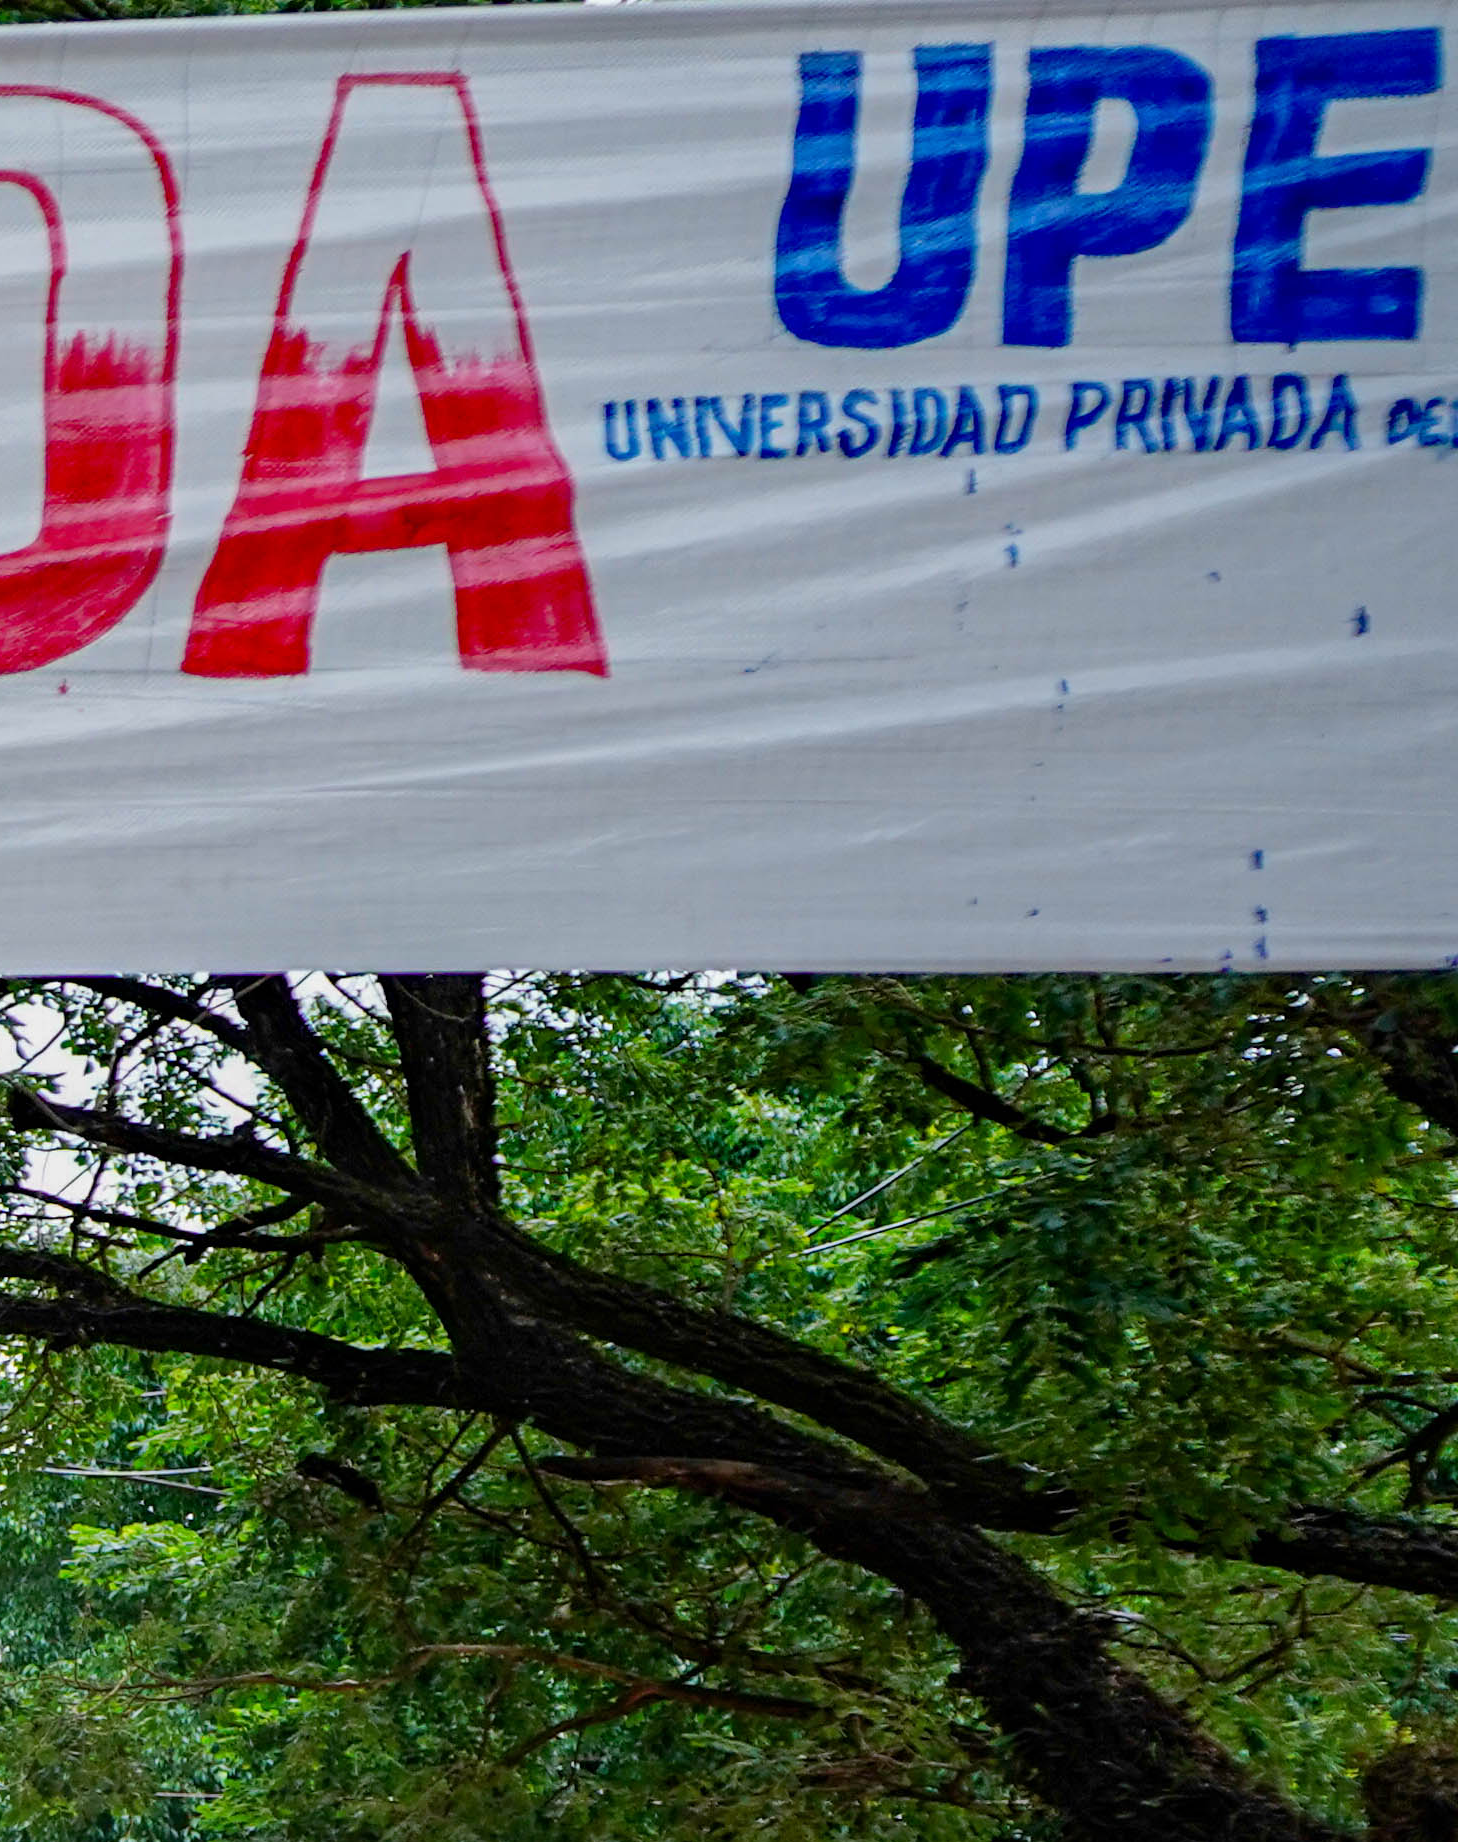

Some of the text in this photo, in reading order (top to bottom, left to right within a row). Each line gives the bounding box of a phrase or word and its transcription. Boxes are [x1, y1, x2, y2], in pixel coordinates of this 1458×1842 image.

[771, 24, 1449, 350] UPE
[602, 373, 1458, 464] UNIVERSIDAD PRIVADA DE
